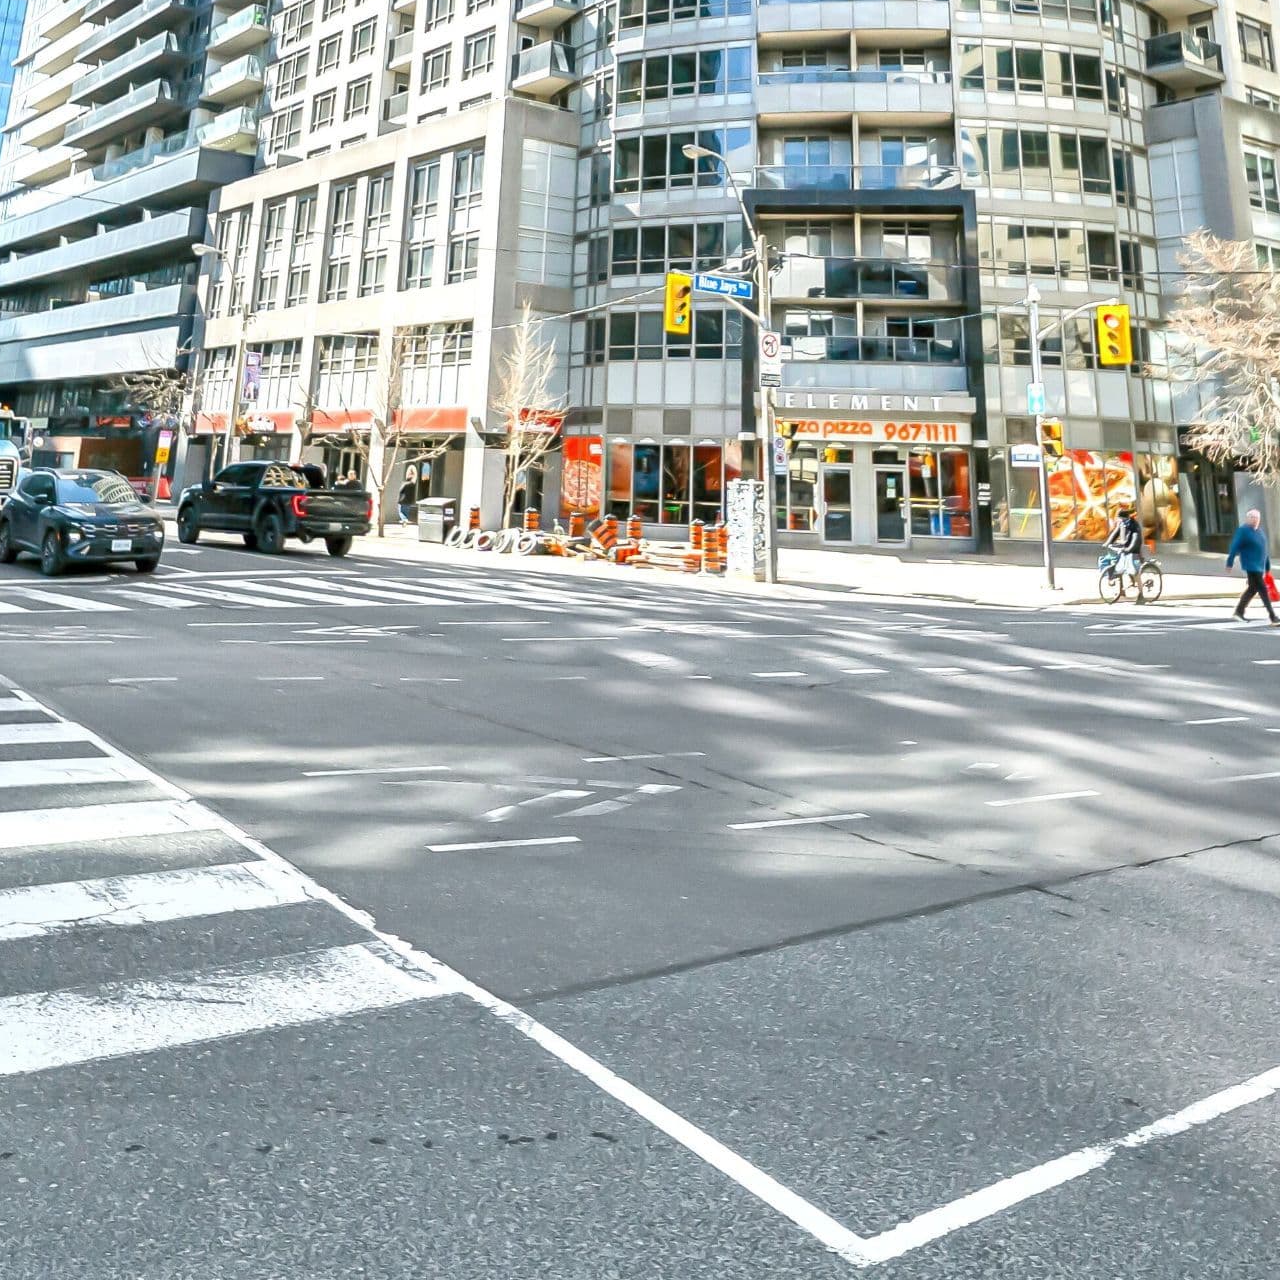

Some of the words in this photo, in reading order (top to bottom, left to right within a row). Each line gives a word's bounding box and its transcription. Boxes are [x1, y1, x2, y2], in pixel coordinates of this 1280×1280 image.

[699, 275, 718, 290] Blue
[720, 280, 738, 295] Jays
[784, 392, 944, 411] ELEMENT
[823, 421, 872, 438] pizza
